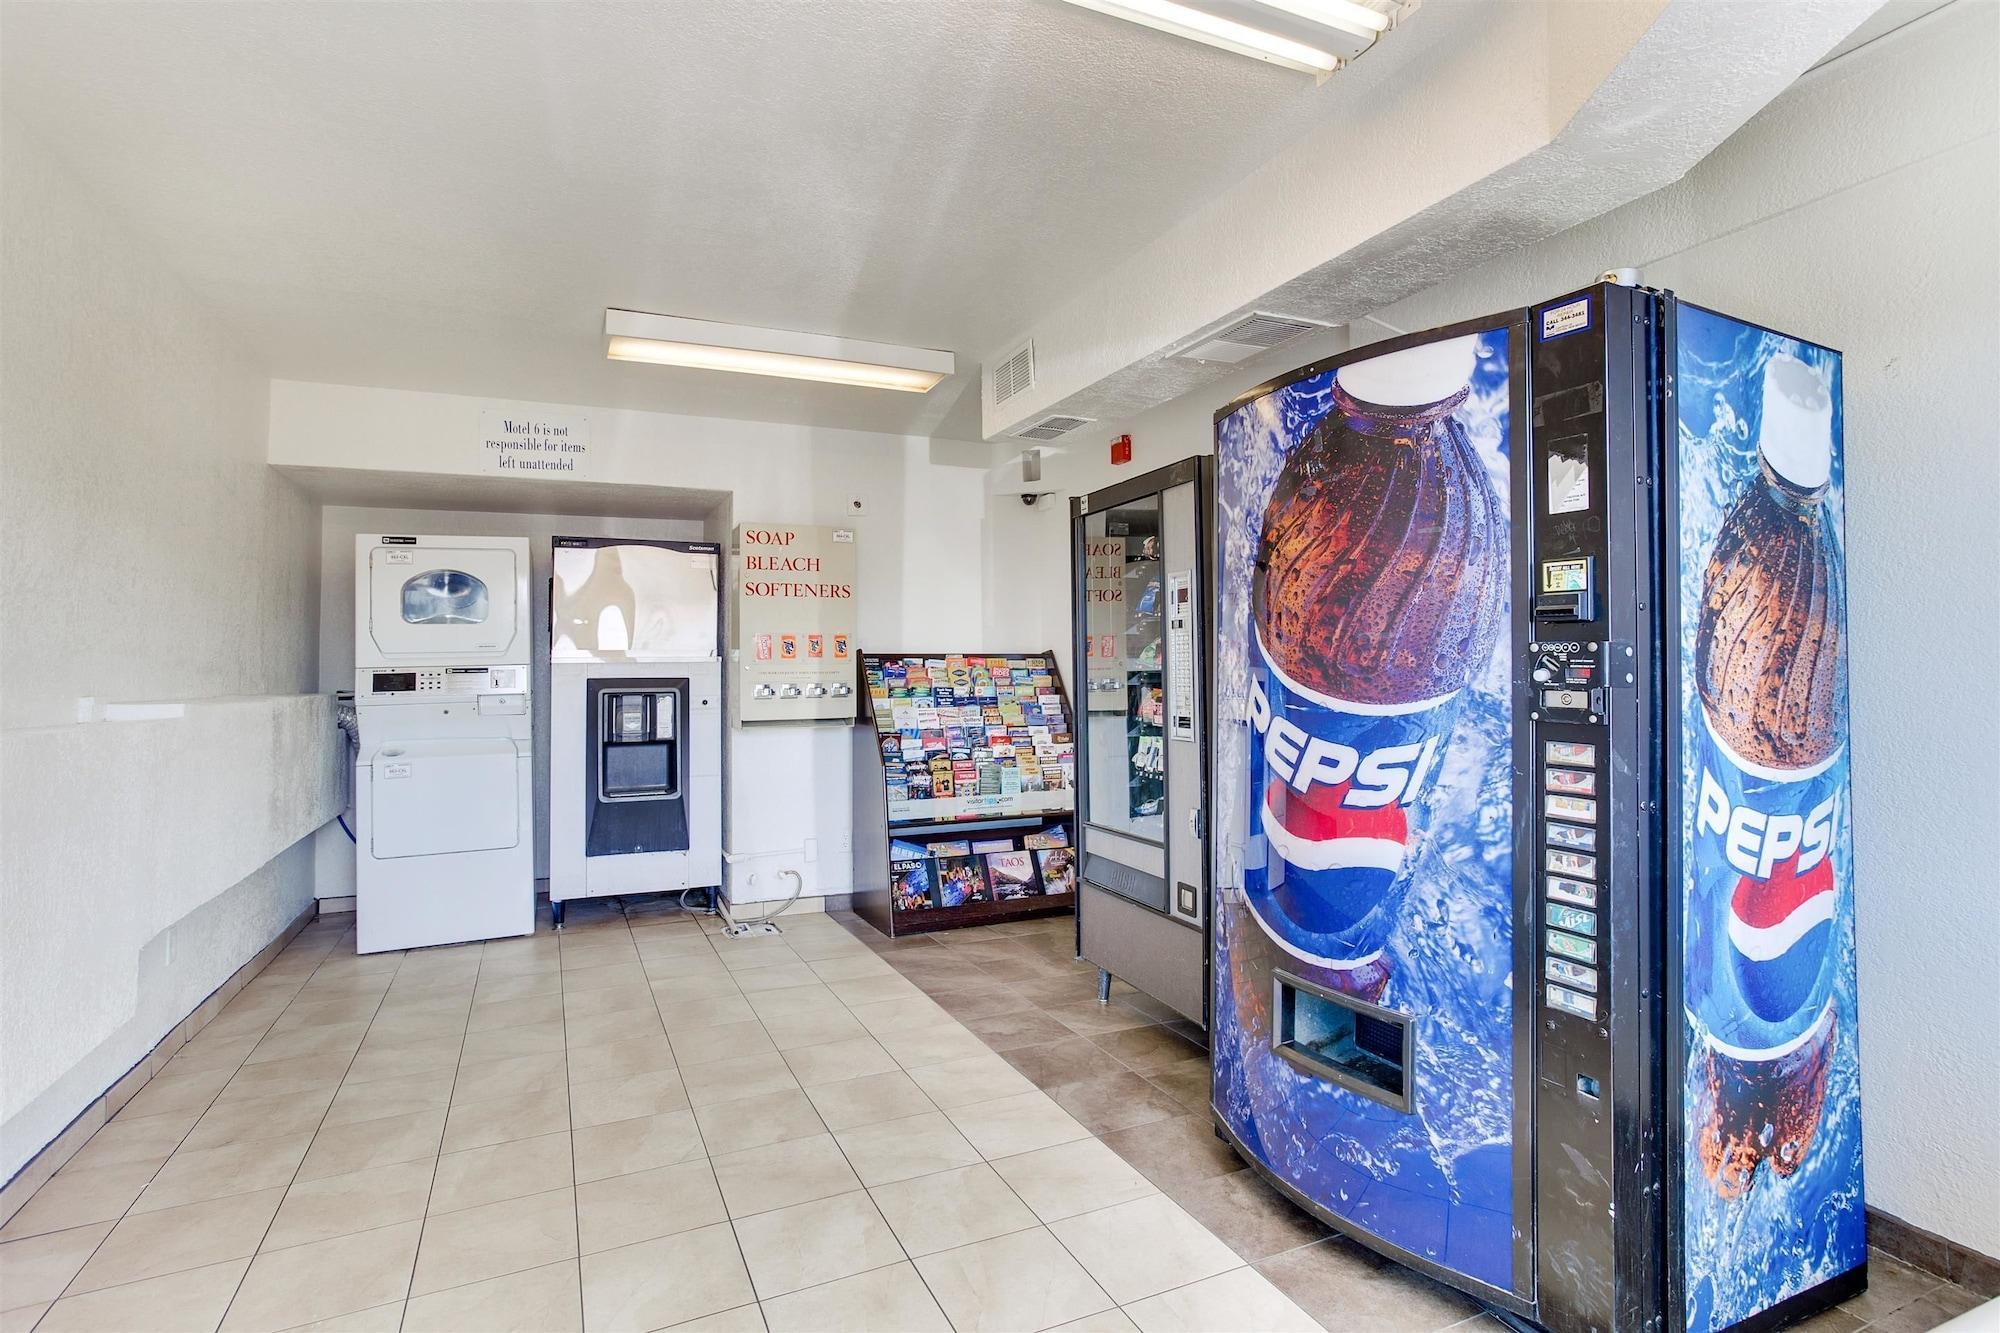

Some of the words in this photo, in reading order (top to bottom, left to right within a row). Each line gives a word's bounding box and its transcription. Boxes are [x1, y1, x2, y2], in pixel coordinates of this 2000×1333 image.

[504, 420, 530, 434] Motel
[534, 423, 540, 434] 6
[543, 423, 551, 435] is
[553, 426, 568, 436] not
[486, 438, 541, 453] responsible
[544, 438, 558, 451] for
[561, 440, 586, 453] items
[499, 455, 515, 469] left
[519, 458, 574, 471] unattended
[746, 530, 795, 546] SOAP
[746, 556, 820, 572] BLEACH
[745, 582, 851, 599] SOFTENERS
[1247, 672, 1441, 808] PEPSI
[1697, 766, 1841, 880] PEPSI
[902, 861, 922, 870] PASO
[1001, 856, 1025, 867] TAOS
